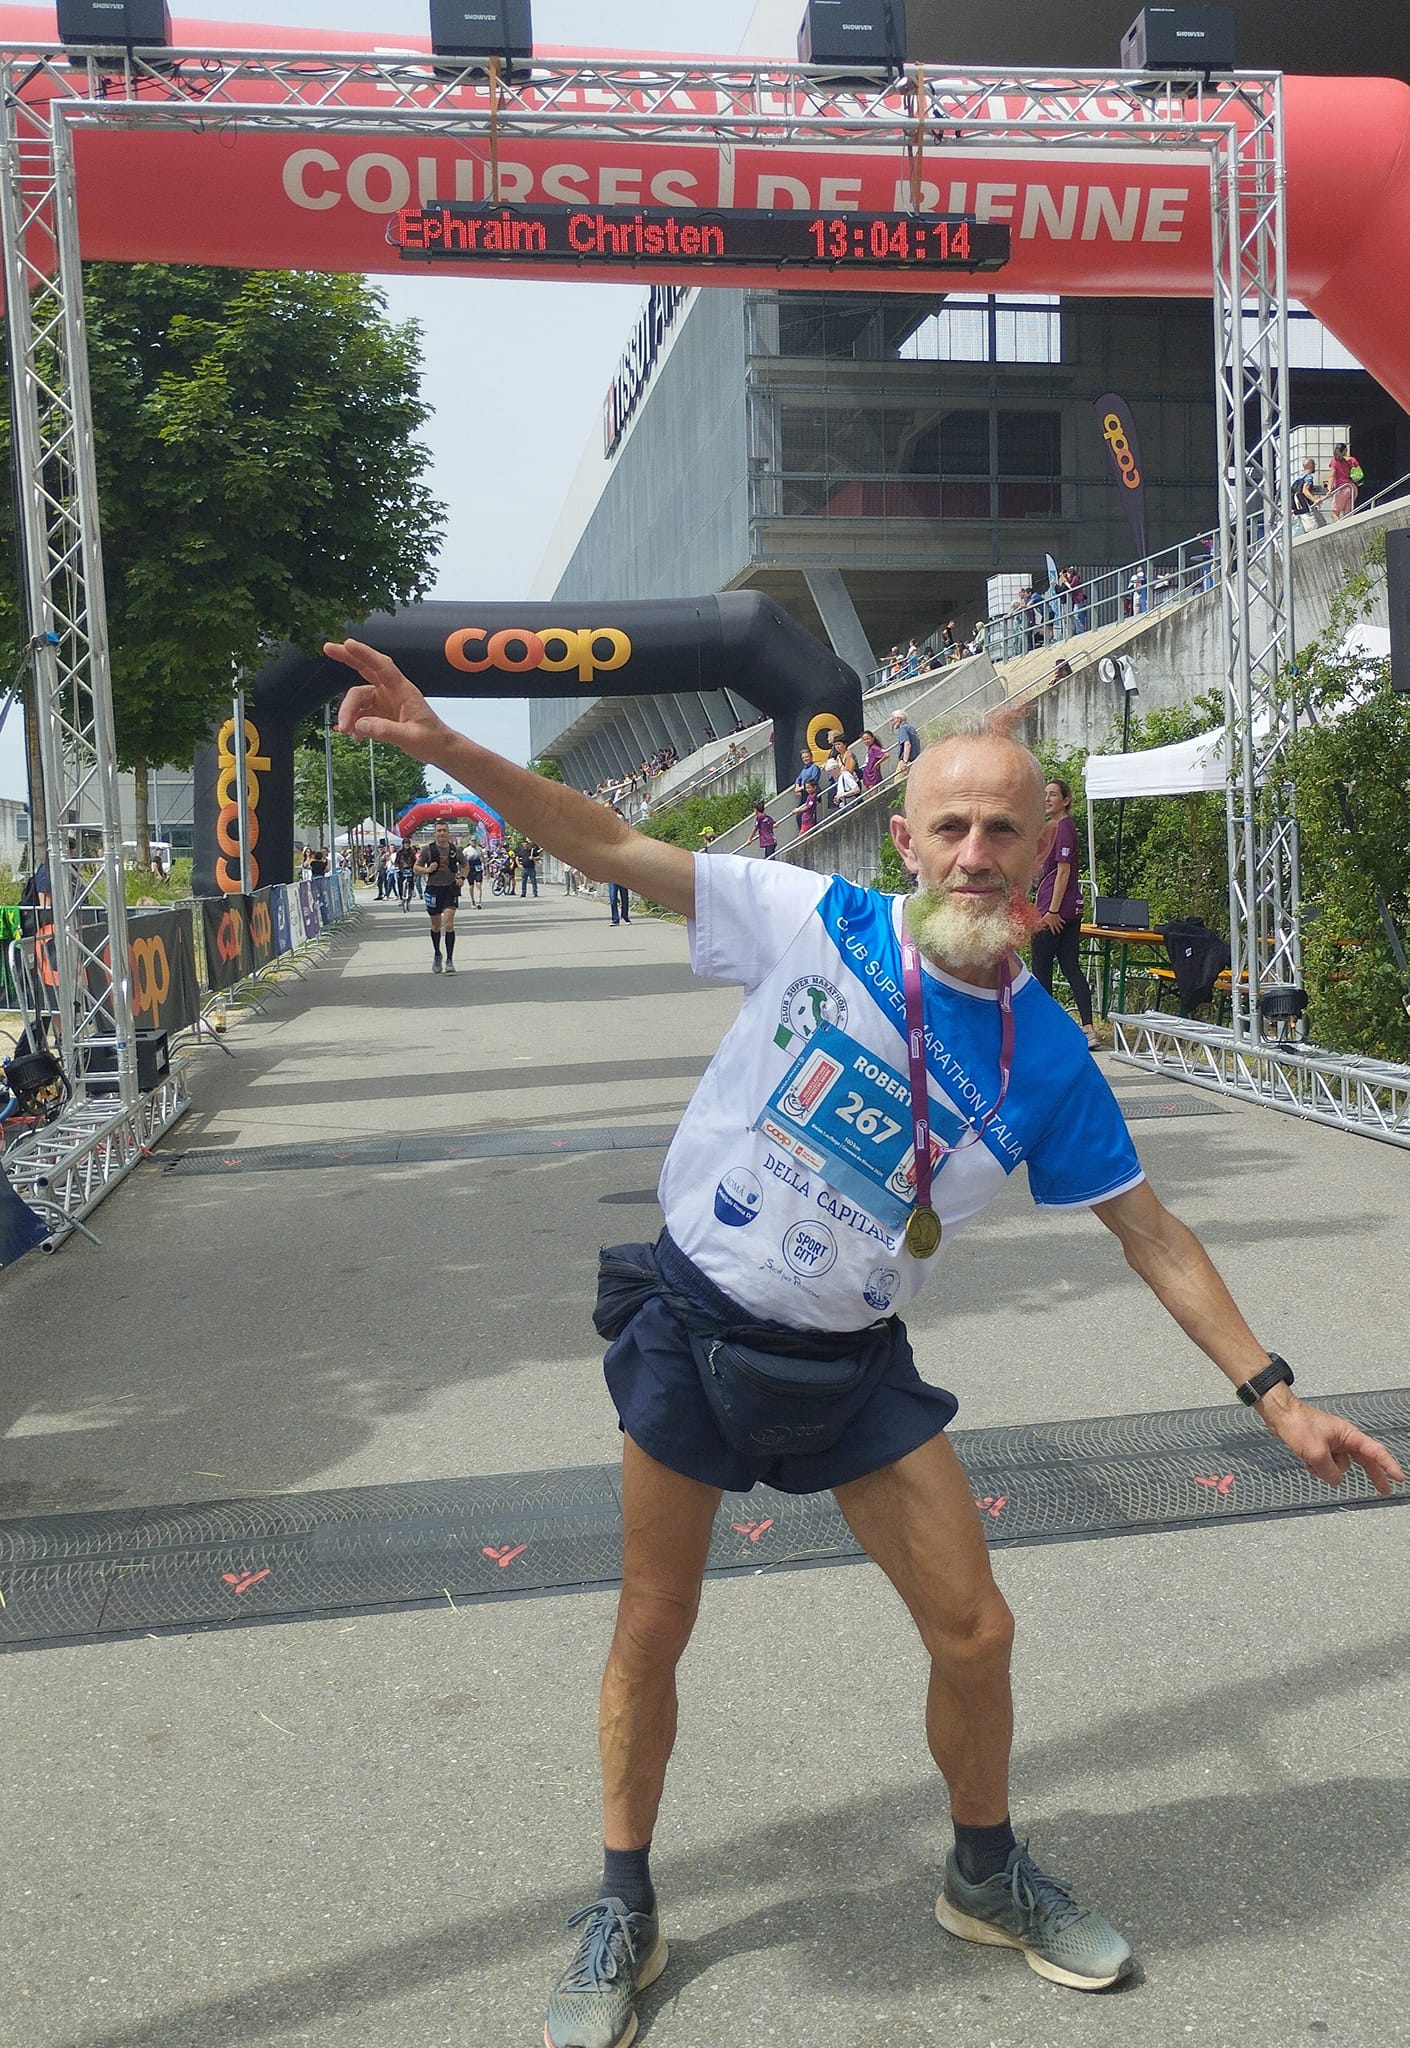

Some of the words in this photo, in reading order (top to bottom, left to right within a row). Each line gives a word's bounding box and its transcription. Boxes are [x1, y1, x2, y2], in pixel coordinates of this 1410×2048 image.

[282, 148, 700, 214] COURSES
[756, 173, 863, 211] DE
[893, 179, 1190, 243] BIENNE
[398, 208, 547, 252] Ephraim
[567, 212, 725, 256] Christen
[808, 218, 971, 260] 13:04:14
[1102, 412, 1142, 490] coop
[444, 627, 633, 683] coop
[215, 717, 272, 894] coop
[786, 978, 810, 998] SUPER
[812, 977, 846, 1012] MARATHON
[923, 1023, 988, 1111] ARATHON
[766, 1123, 792, 1146] coop
[834, 1090, 903, 1145] 267
[762, 1153, 810, 1198] DELLA
[793, 1245, 819, 1267] CITY
[795, 1231, 829, 1258] SPORT
